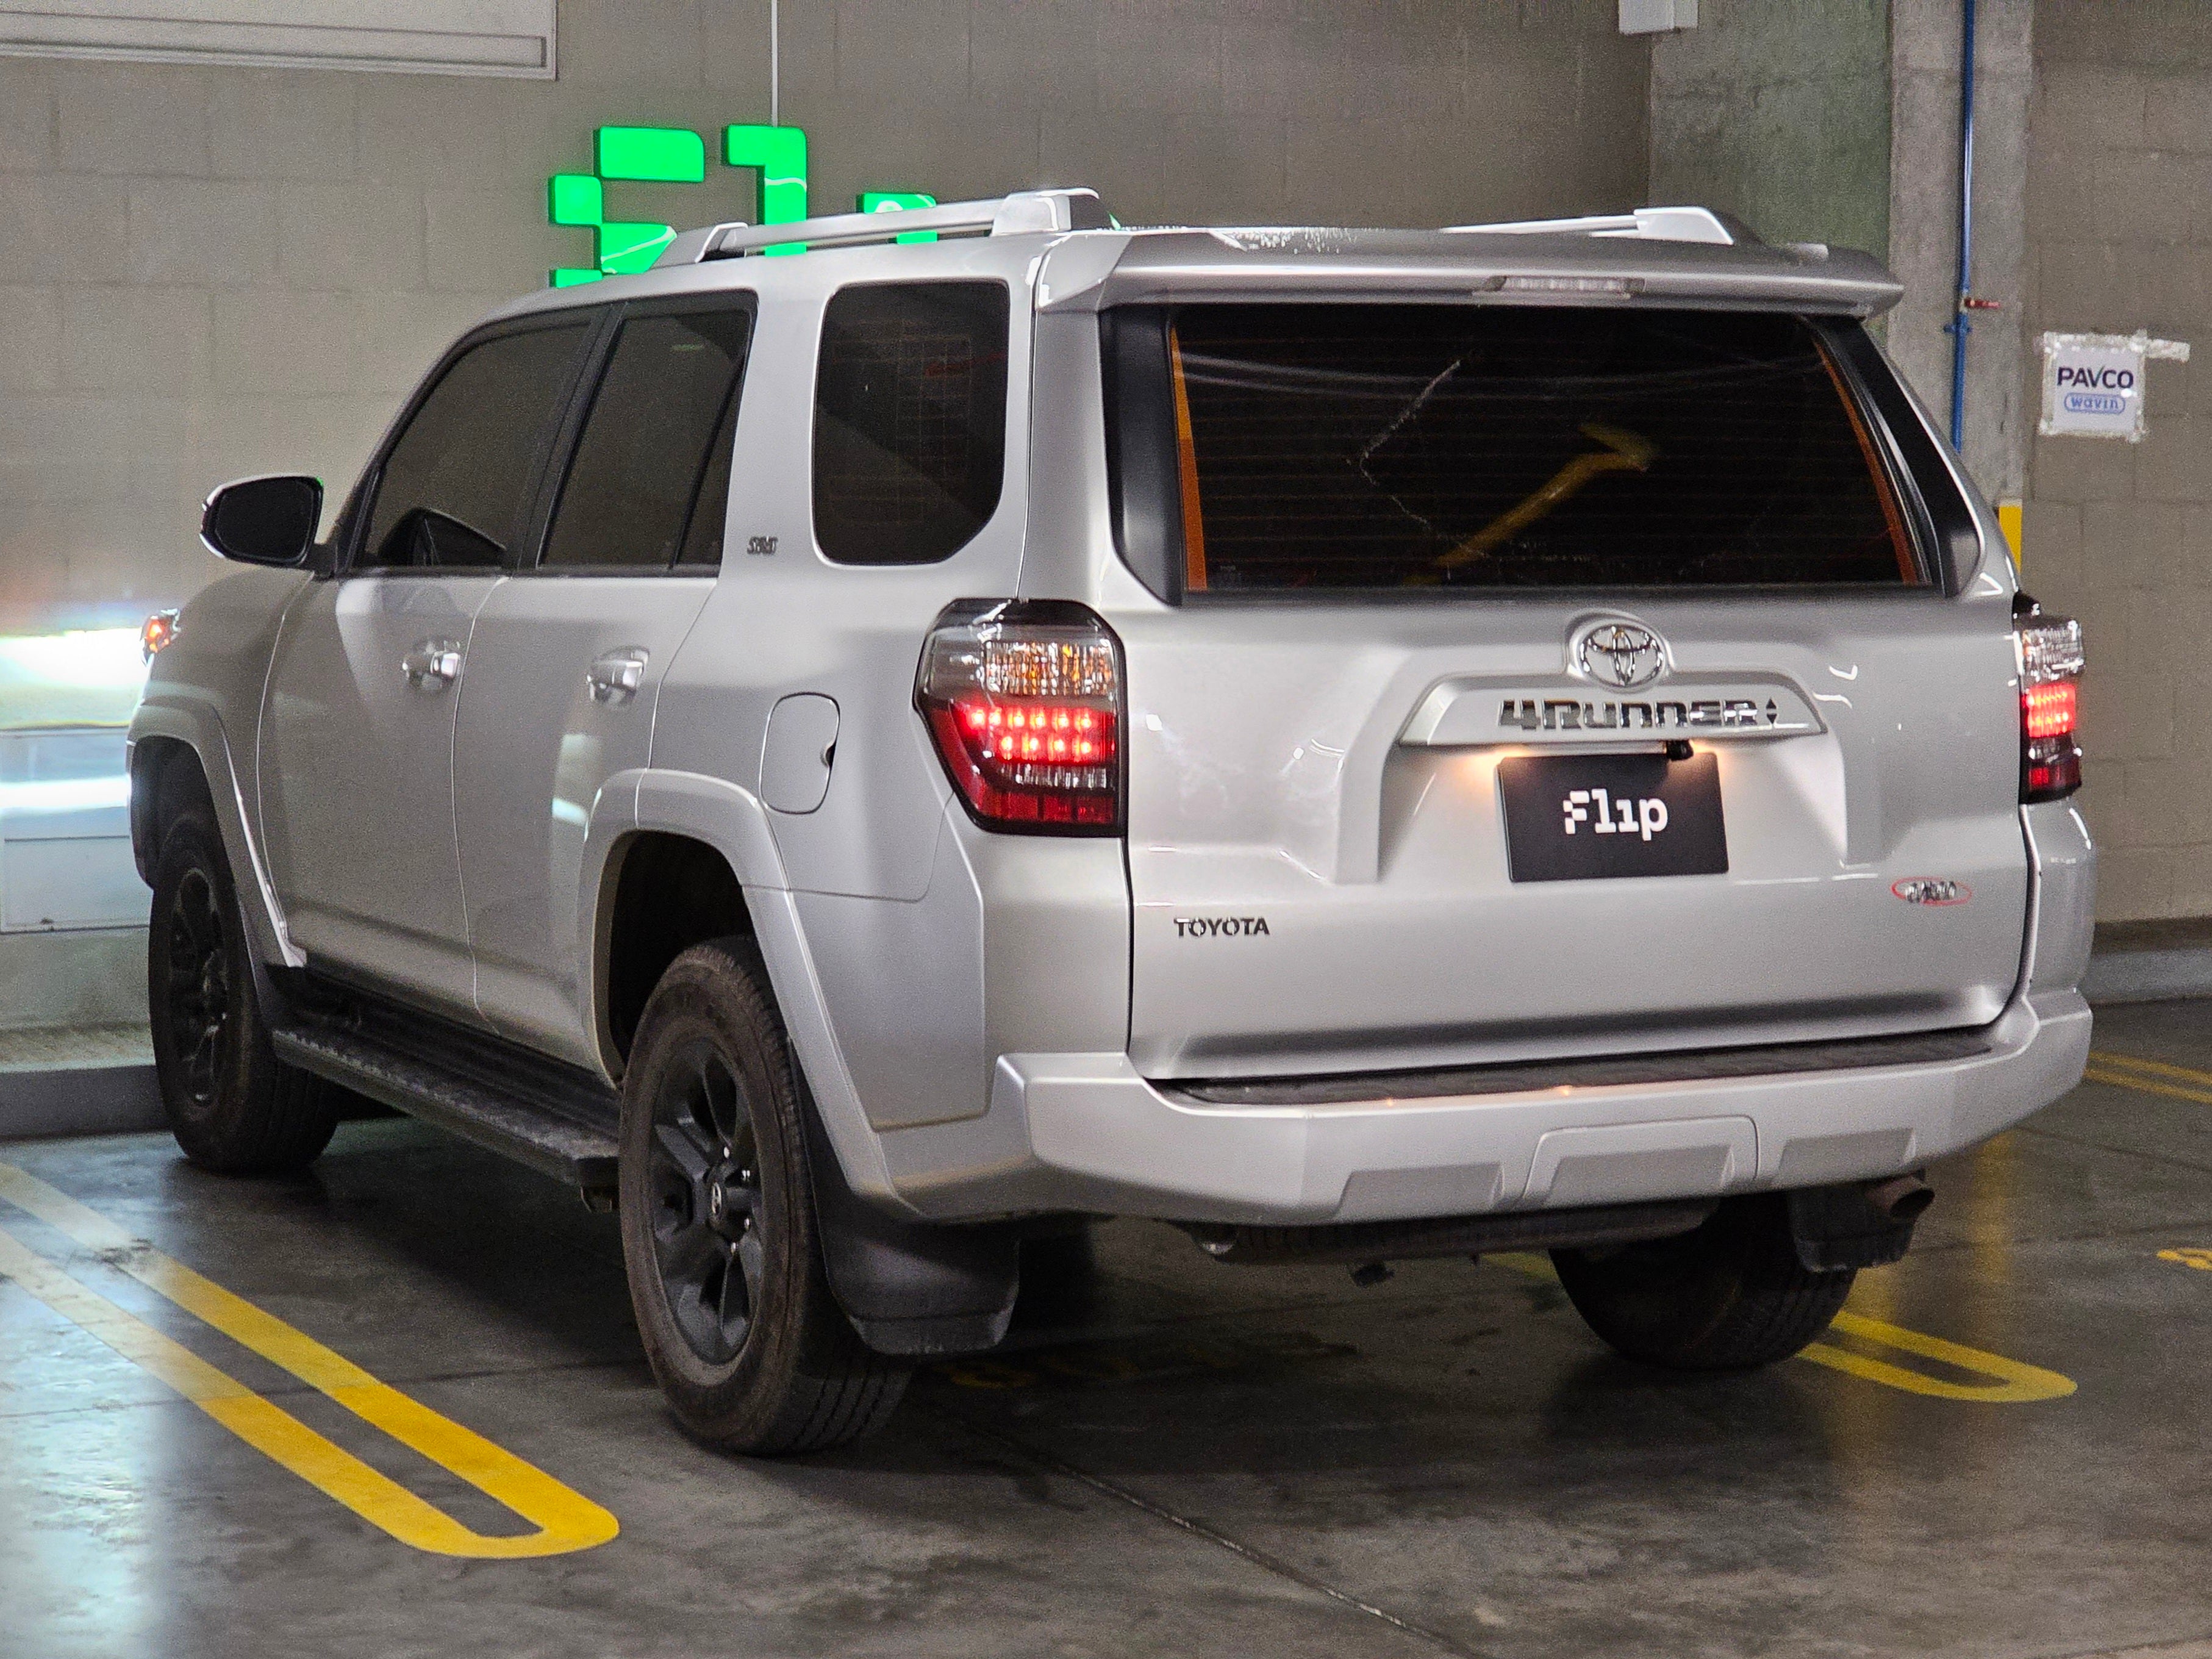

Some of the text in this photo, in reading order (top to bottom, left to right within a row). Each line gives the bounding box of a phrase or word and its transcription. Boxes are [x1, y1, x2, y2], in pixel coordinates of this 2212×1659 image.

[2056, 366, 2134, 389] PAVCO
[2071, 396, 2119, 409] wavin
[1498, 700, 1758, 730] 4RUNNER
[1173, 917, 1270, 937] TOYOTA
